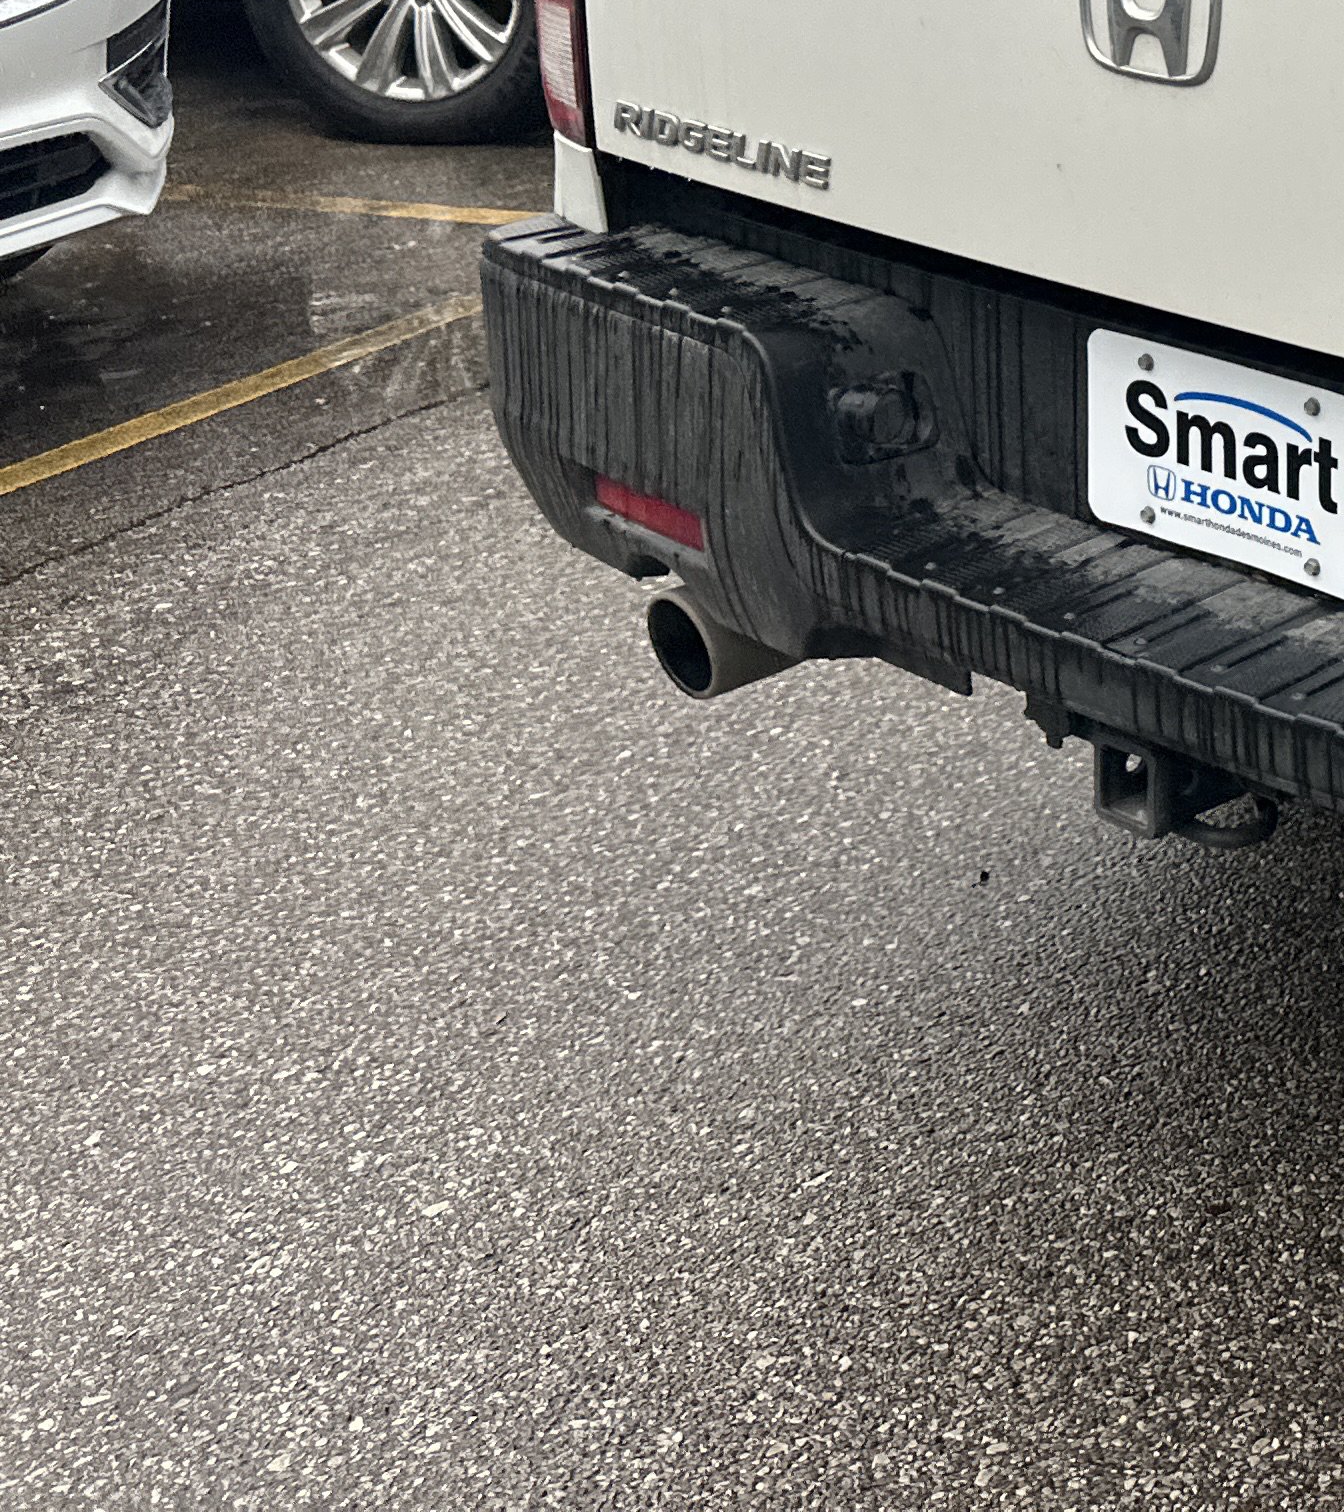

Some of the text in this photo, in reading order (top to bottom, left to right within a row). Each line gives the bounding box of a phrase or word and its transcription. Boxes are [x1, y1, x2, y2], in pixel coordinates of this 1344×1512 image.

[614, 98, 832, 190] RIDGELINE
[1125, 379, 1338, 515] Smart
[1181, 478, 1321, 545] HONDA
